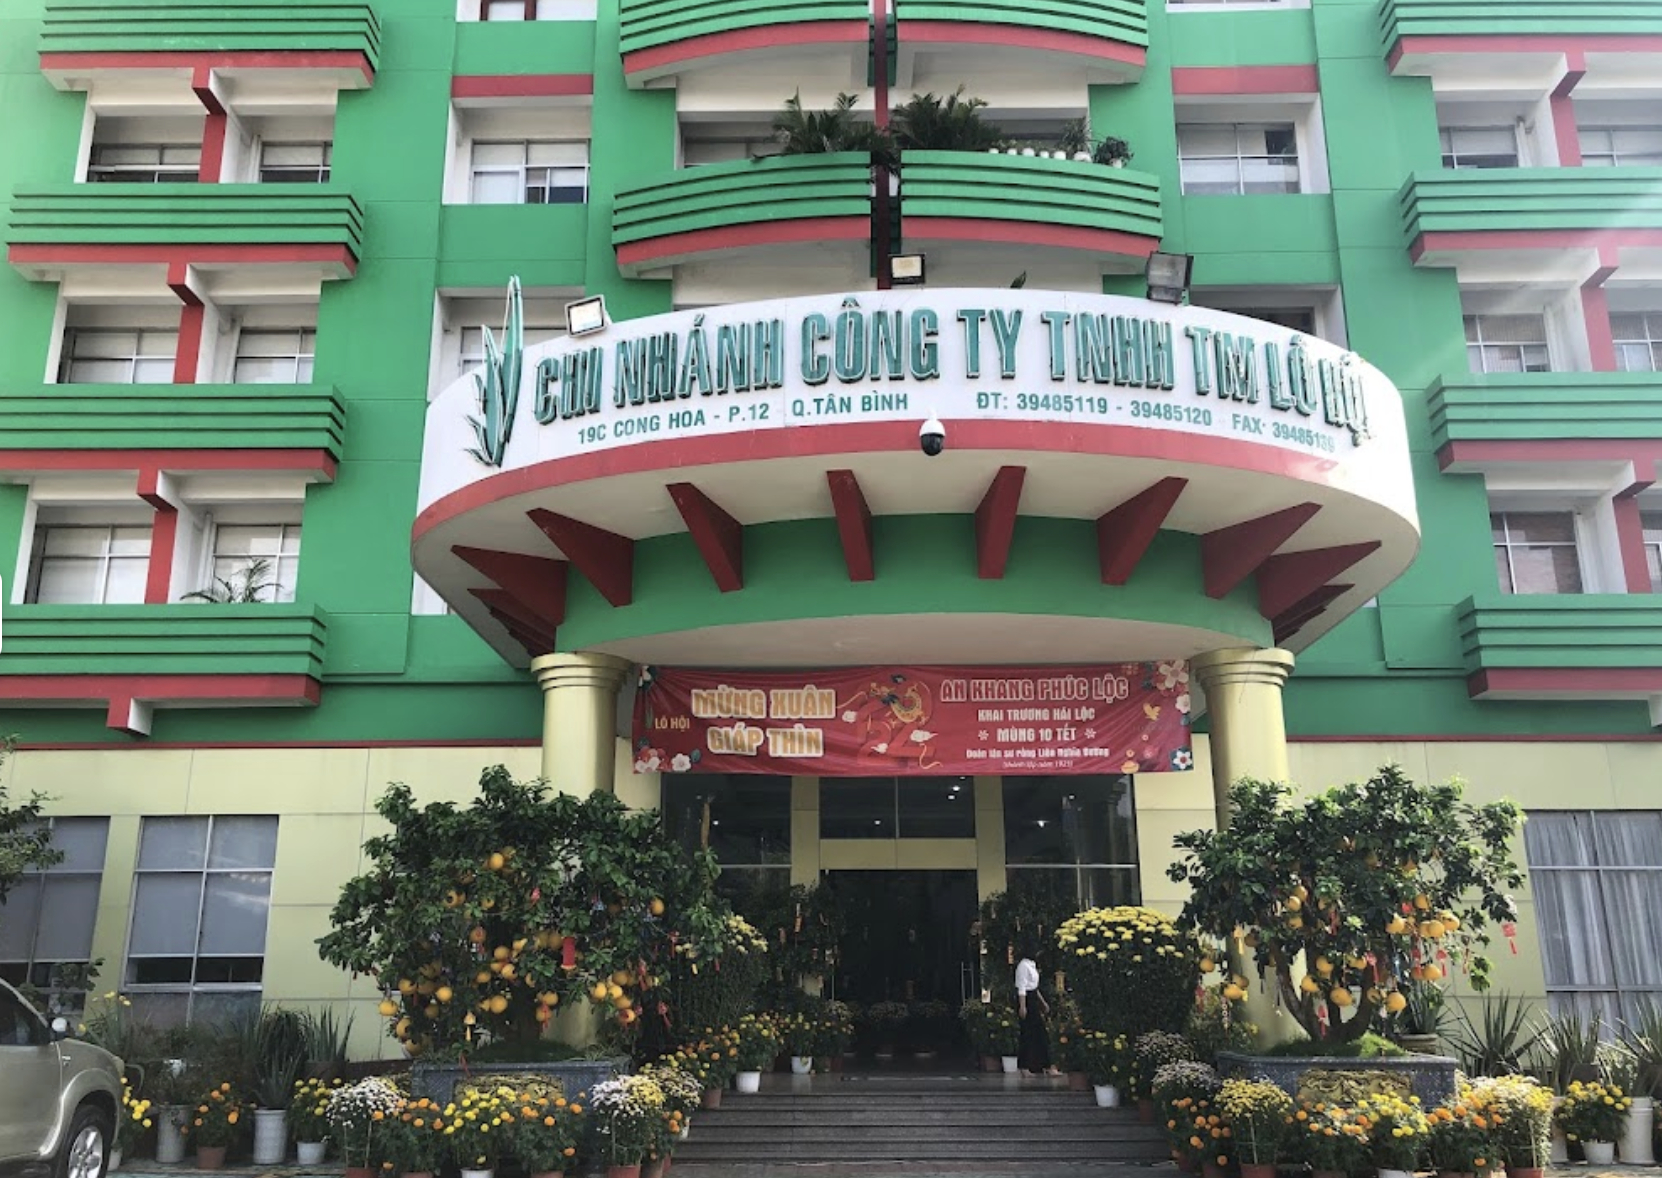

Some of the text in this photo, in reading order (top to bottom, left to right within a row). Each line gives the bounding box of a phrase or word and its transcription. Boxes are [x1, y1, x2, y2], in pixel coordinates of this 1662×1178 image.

[533, 346, 604, 425] CHI
[613, 314, 785, 408] NHÁNH
[800, 297, 941, 386] CÔNG
[957, 308, 1024, 381] TY
[1041, 310, 1176, 391] TNHH
[1185, 325, 1262, 404] TM
[1265, 334, 1317, 417] LÔ
[578, 423, 607, 445] 19C
[613, 414, 661, 438] CONG
[668, 408, 706, 430] HOA
[728, 403, 770, 422] P.12
[792, 396, 852, 417] Q.TÂN
[861, 393, 909, 412] BÌNH
[976, 392, 1009, 410] ĐT:
[1016, 393, 1108, 414] 39485119
[1130, 400, 1212, 426] 39485120
[691, 684, 767, 719] MỪNG
[769, 684, 836, 719] XUÂN
[940, 679, 967, 702] AN
[970, 679, 1035, 701] KHANG
[1037, 675, 1089, 701] PHÚC
[1092, 673, 1129, 704] LỘC
[670, 715, 690, 733] HỘI
[978, 709, 1004, 721] KHAI
[1053, 706, 1072, 720] HÁI
[1075, 706, 1095, 722] LỘC
[707, 721, 823, 757] GIÁP THÌN
[1039, 727, 1053, 742] 10
[1056, 722, 1077, 741] TẾT
